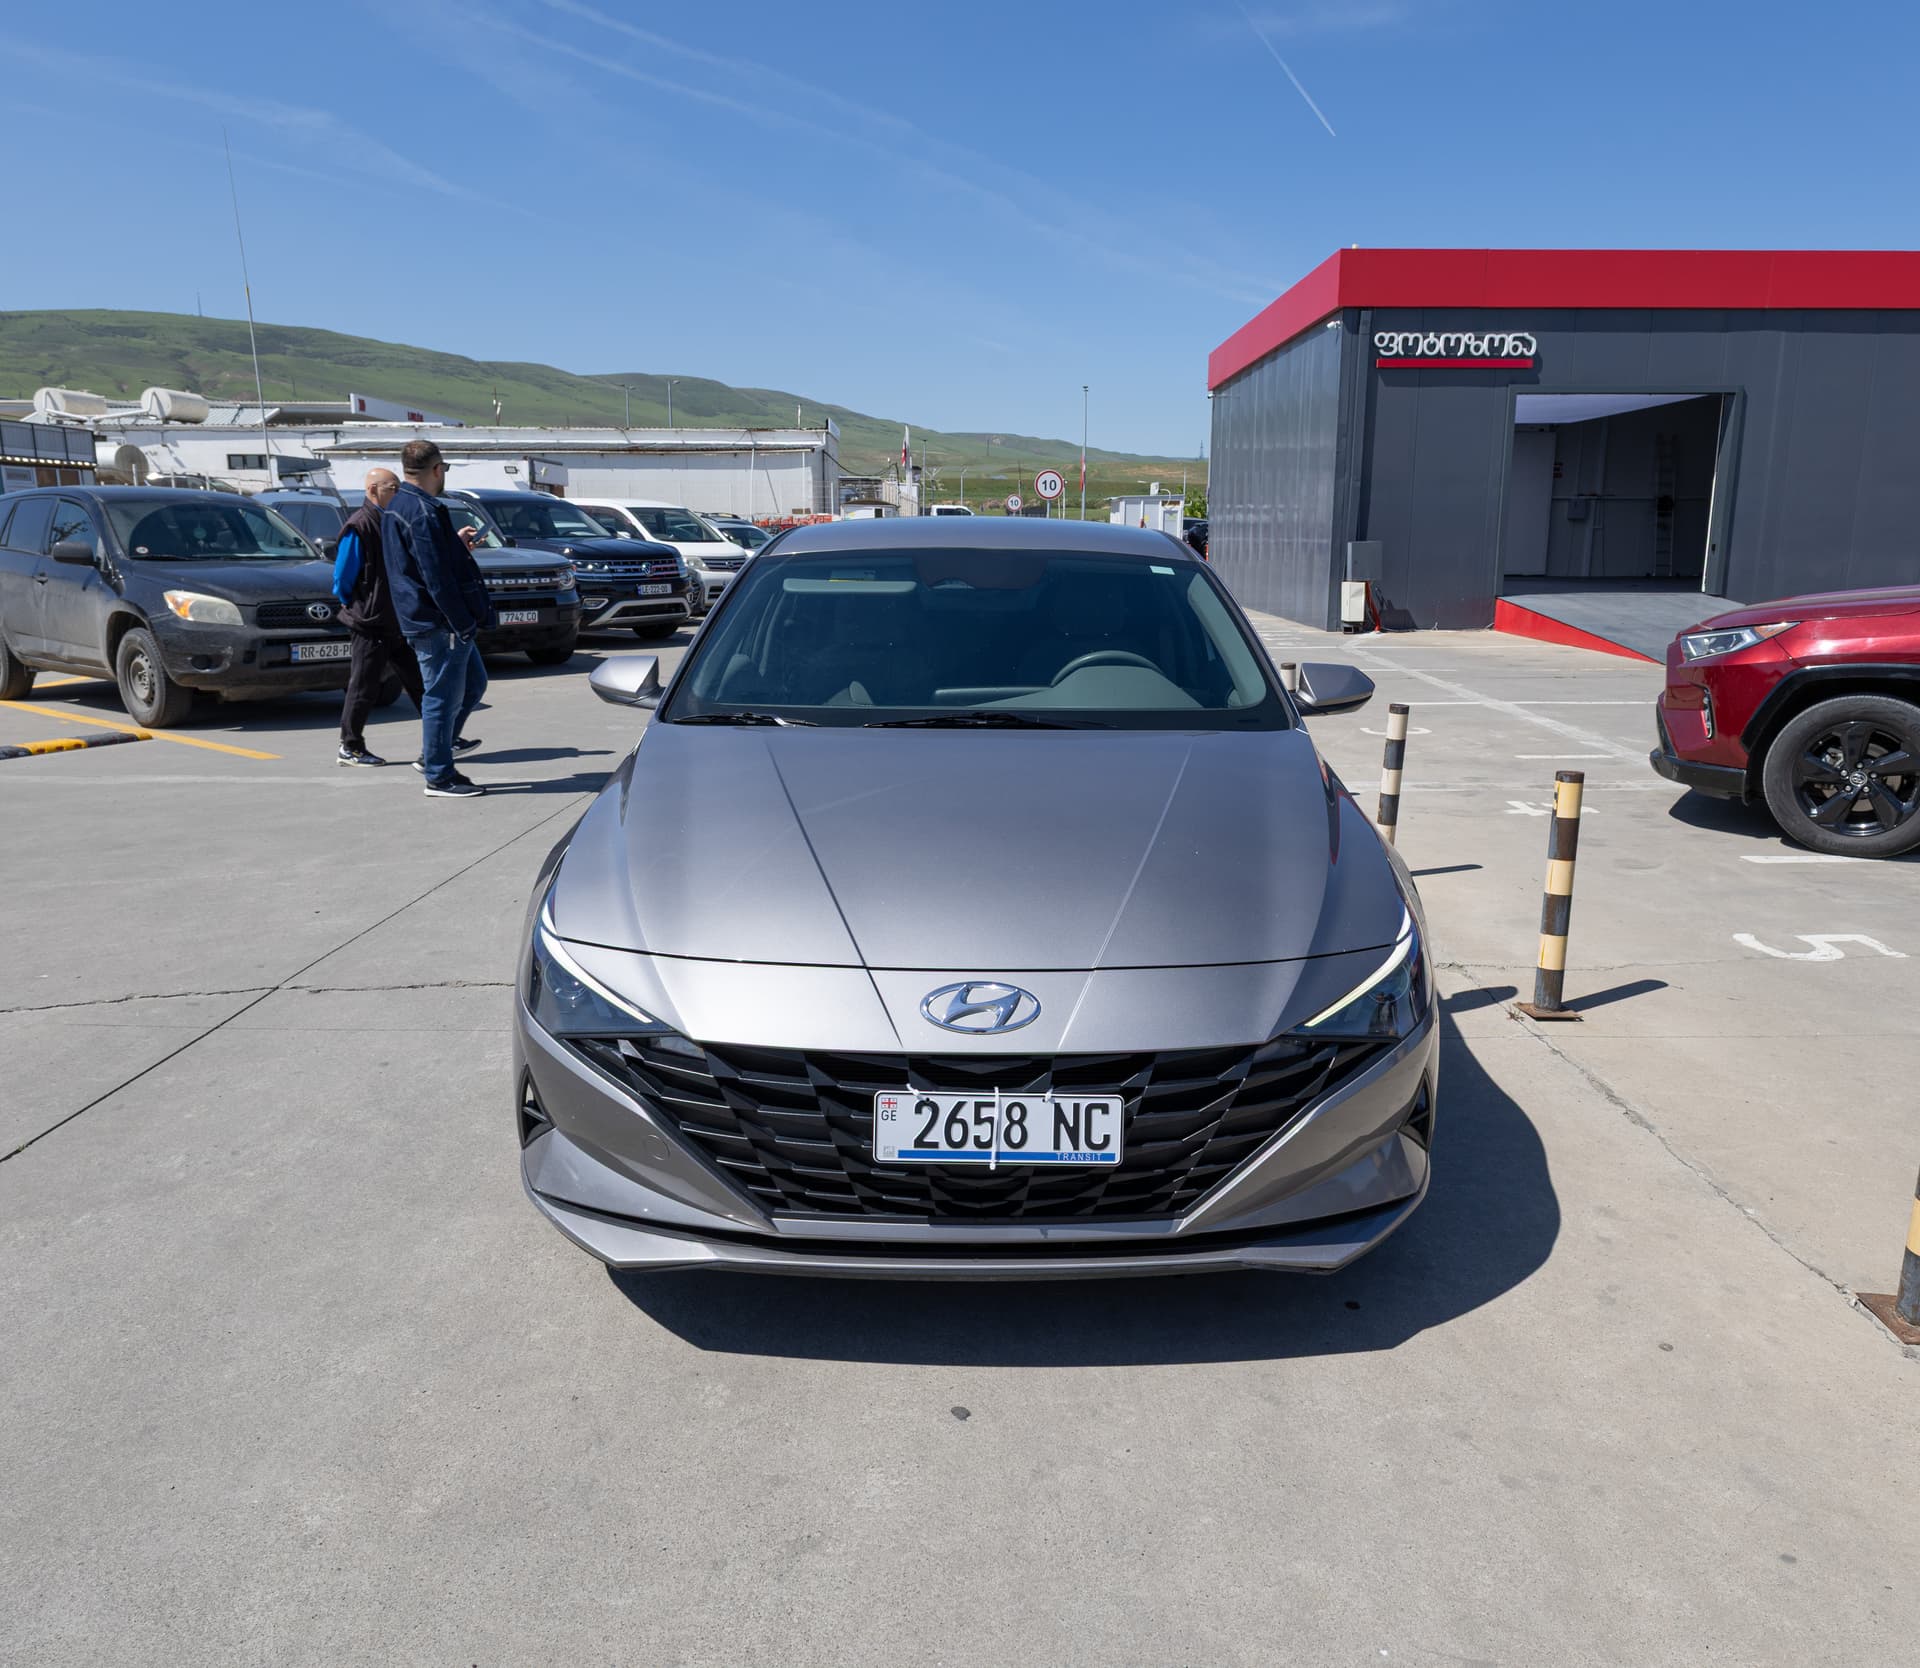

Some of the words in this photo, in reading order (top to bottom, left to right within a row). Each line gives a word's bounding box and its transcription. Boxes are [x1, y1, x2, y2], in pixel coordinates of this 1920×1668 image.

[1374, 332, 1537, 357] ფოტოზონა
[1042, 480, 1057, 491] 10
[301, 645, 352, 658] RR-628-P
[1732, 932, 1910, 962] 5
[881, 1110, 897, 1121] GE
[913, 1100, 1029, 1150] 2658
[1053, 1102, 1111, 1151] NC
[1056, 1152, 1103, 1161] TRANSIT
